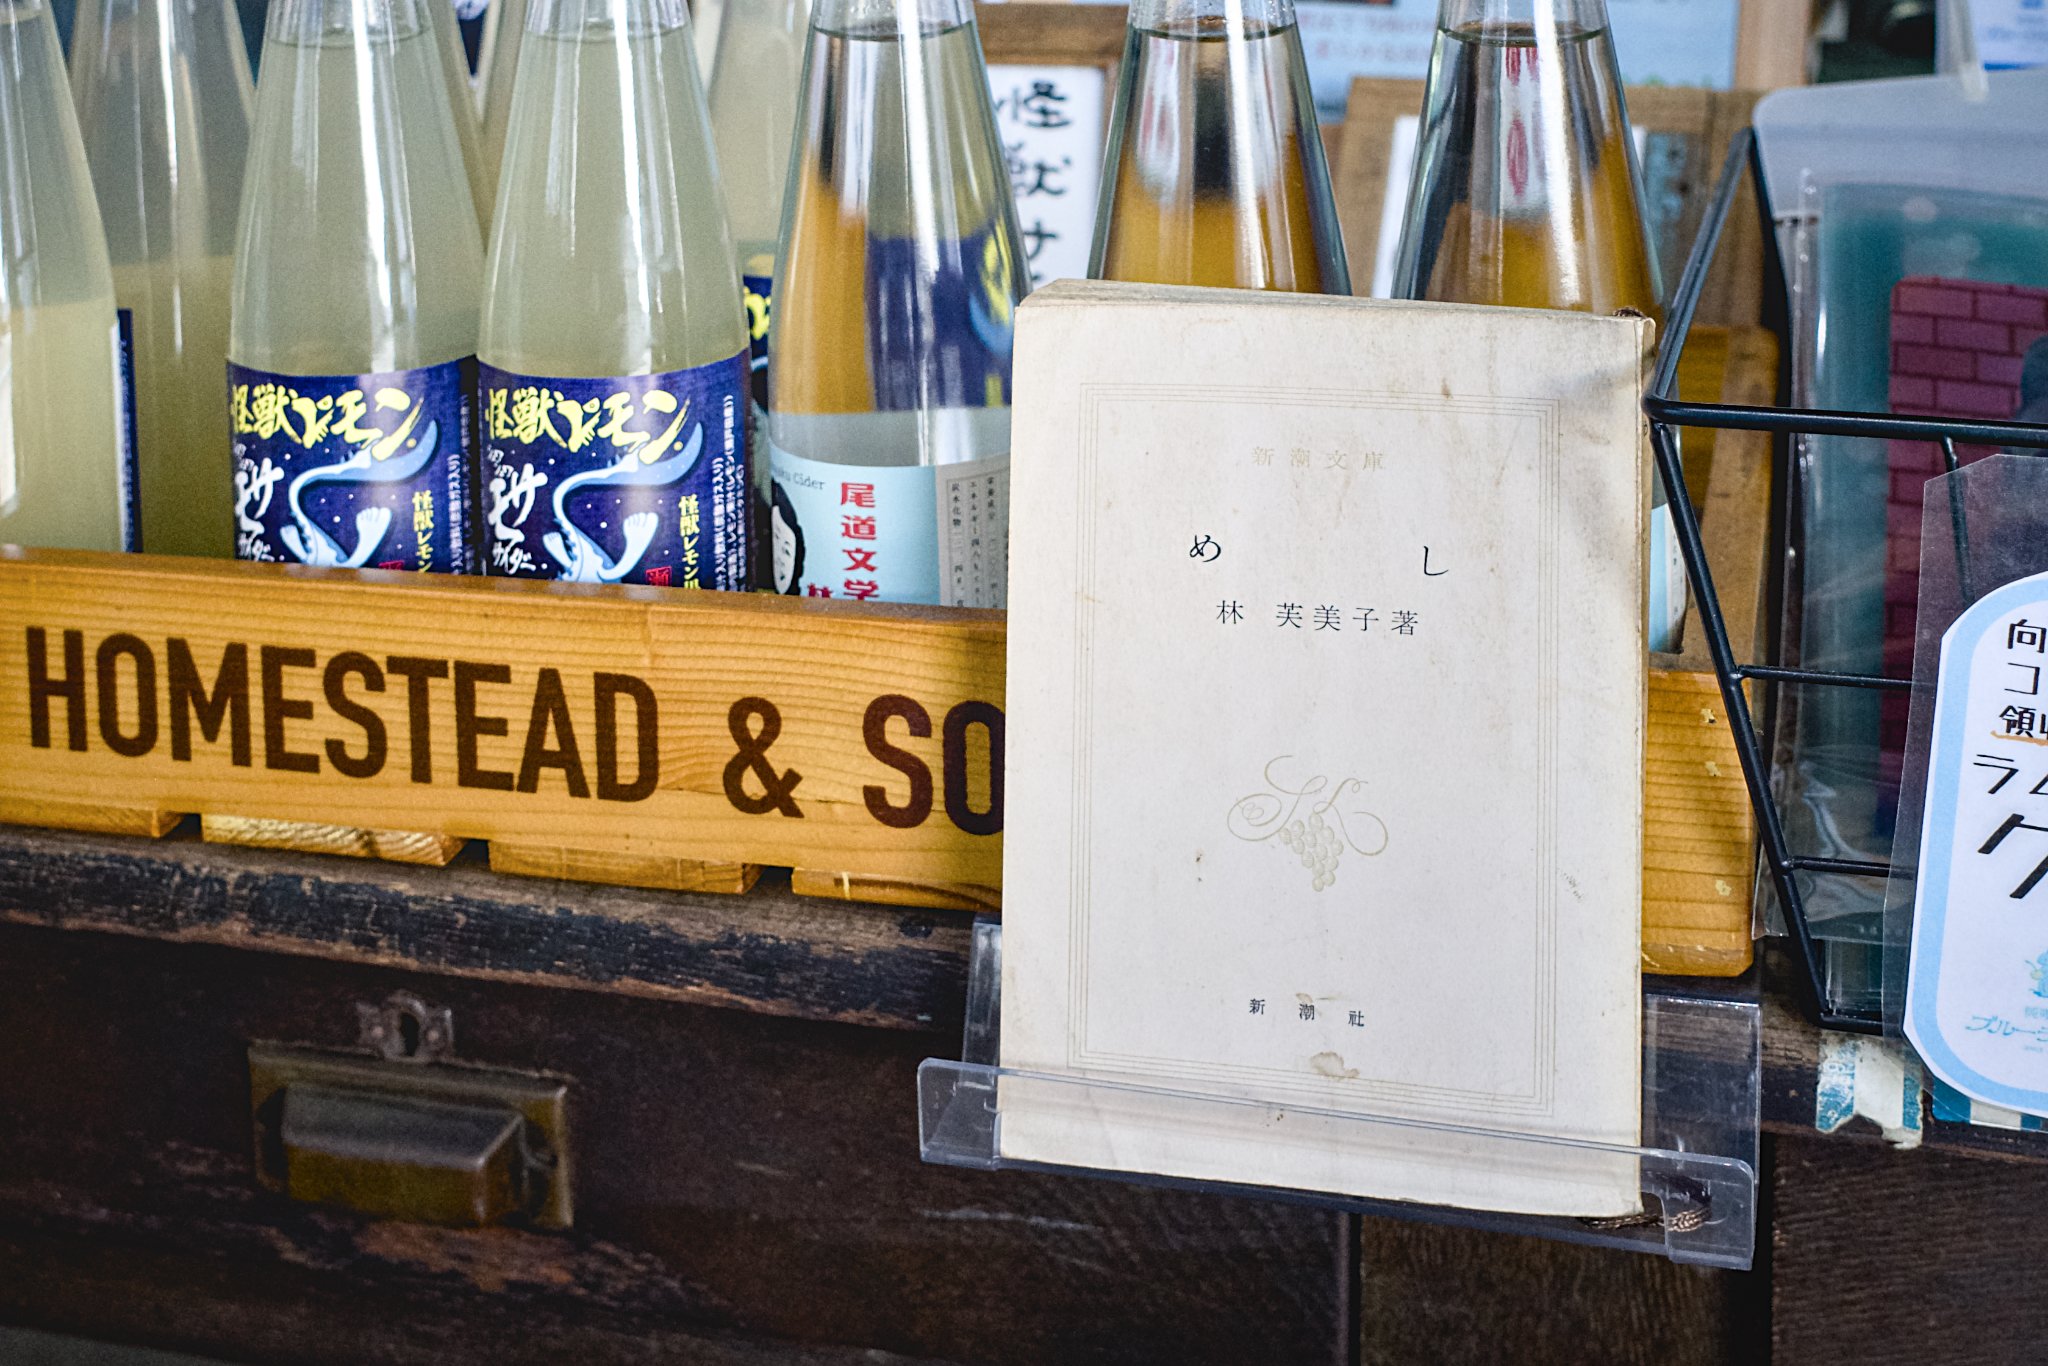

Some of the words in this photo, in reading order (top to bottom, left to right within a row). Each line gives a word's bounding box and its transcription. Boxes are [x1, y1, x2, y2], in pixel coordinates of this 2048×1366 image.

[1251, 446, 1385, 473] 新潮文庫
[840, 481, 880, 600] 尾道文学
[1216, 599, 1244, 625] 林
[1276, 602, 1419, 636] 芙美子著
[26, 625, 660, 803] HOMESTEAD
[722, 696, 805, 818] &
[1249, 998, 1365, 1028] 新潮社
